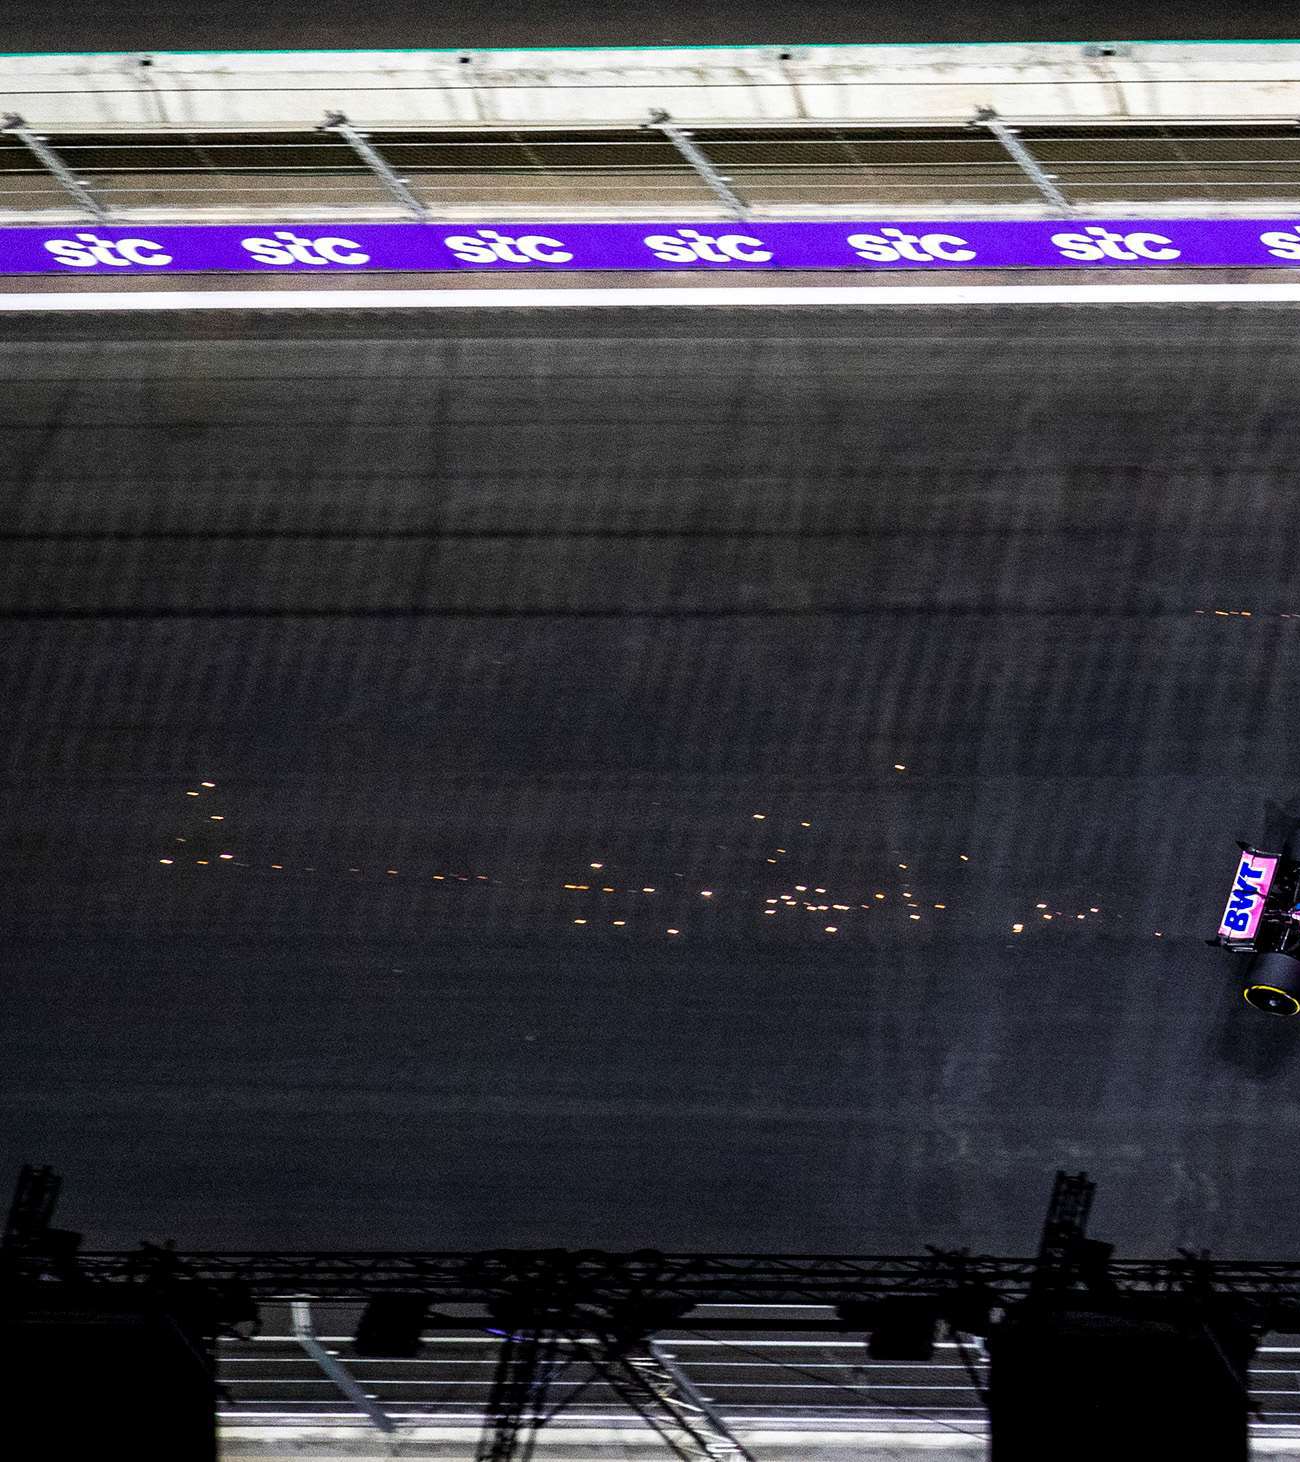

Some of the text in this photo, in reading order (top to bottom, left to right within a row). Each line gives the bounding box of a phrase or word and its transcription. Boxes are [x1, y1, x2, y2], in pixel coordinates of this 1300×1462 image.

[44, 234, 172, 266] stc
[242, 232, 369, 265] stc
[445, 230, 573, 263] stc
[644, 230, 773, 262] stc
[847, 228, 976, 261] stc
[1051, 227, 1180, 260] stc
[1224, 861, 1264, 932] BWT
